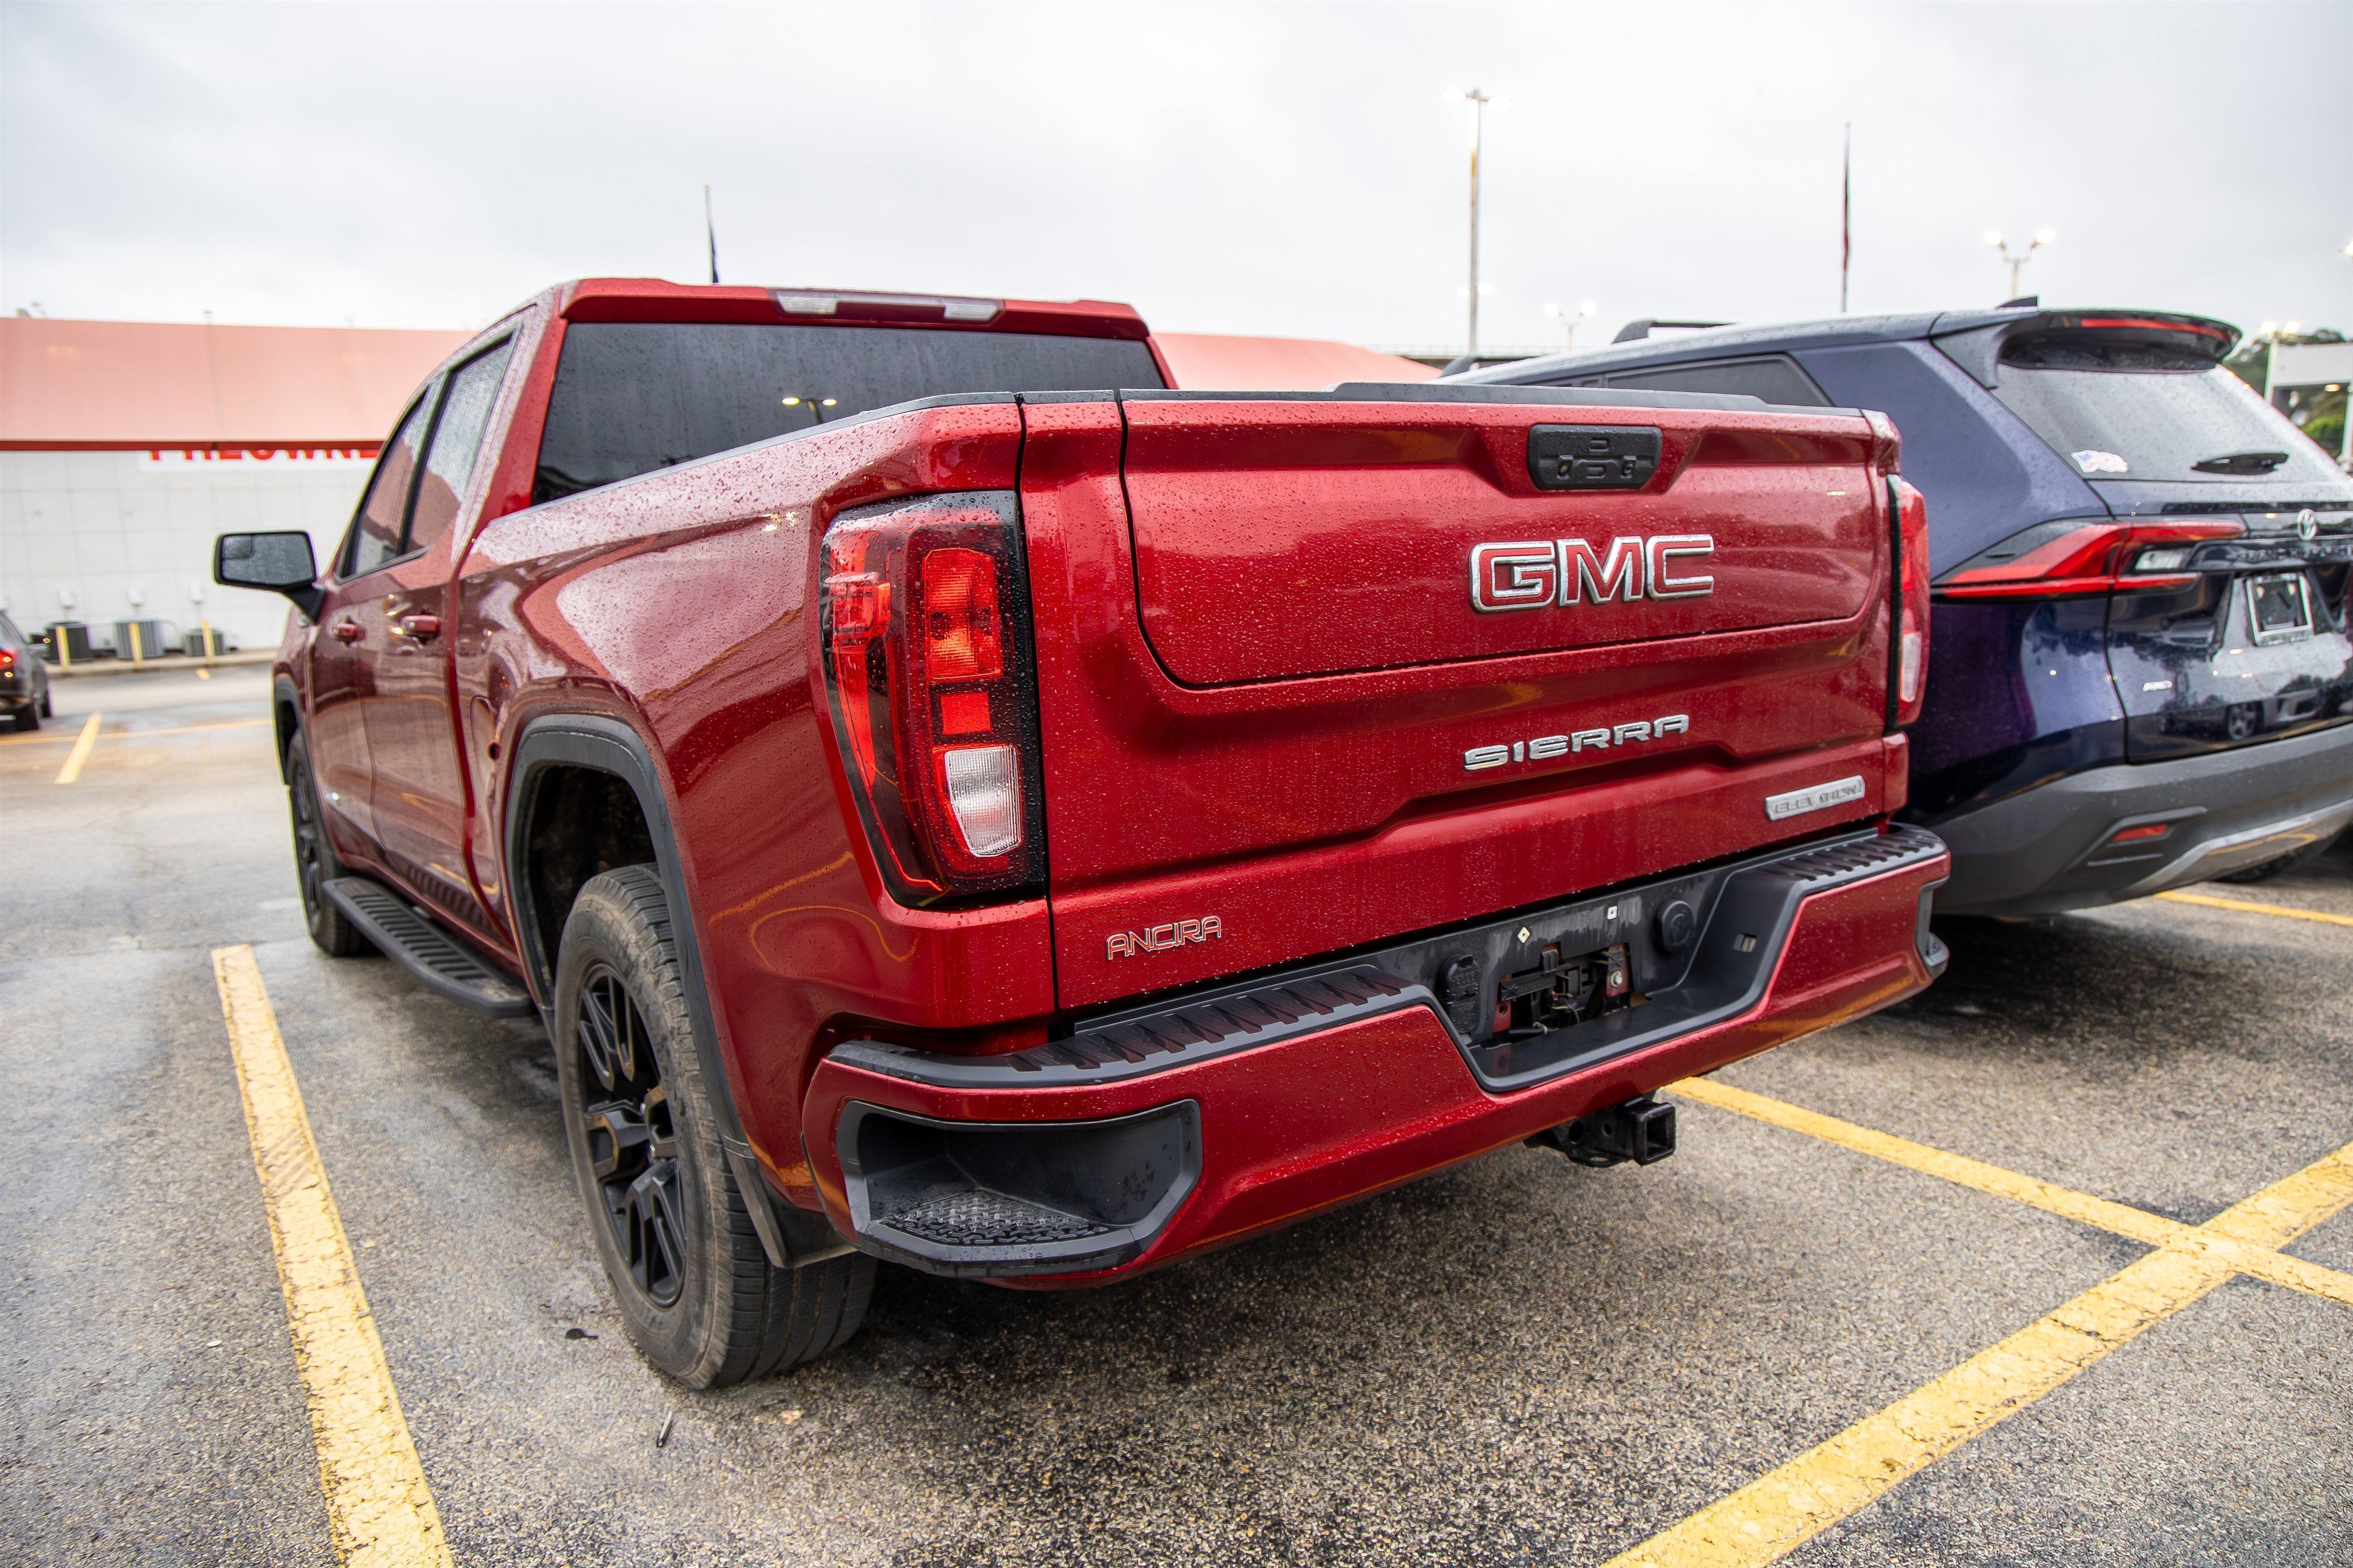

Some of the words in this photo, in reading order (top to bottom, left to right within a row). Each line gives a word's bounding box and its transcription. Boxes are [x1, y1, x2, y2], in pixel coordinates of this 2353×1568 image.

[1471, 534, 1714, 612] GMC
[1464, 714, 1689, 770] SIERRA
[1106, 916, 1221, 960] ANCIRA
